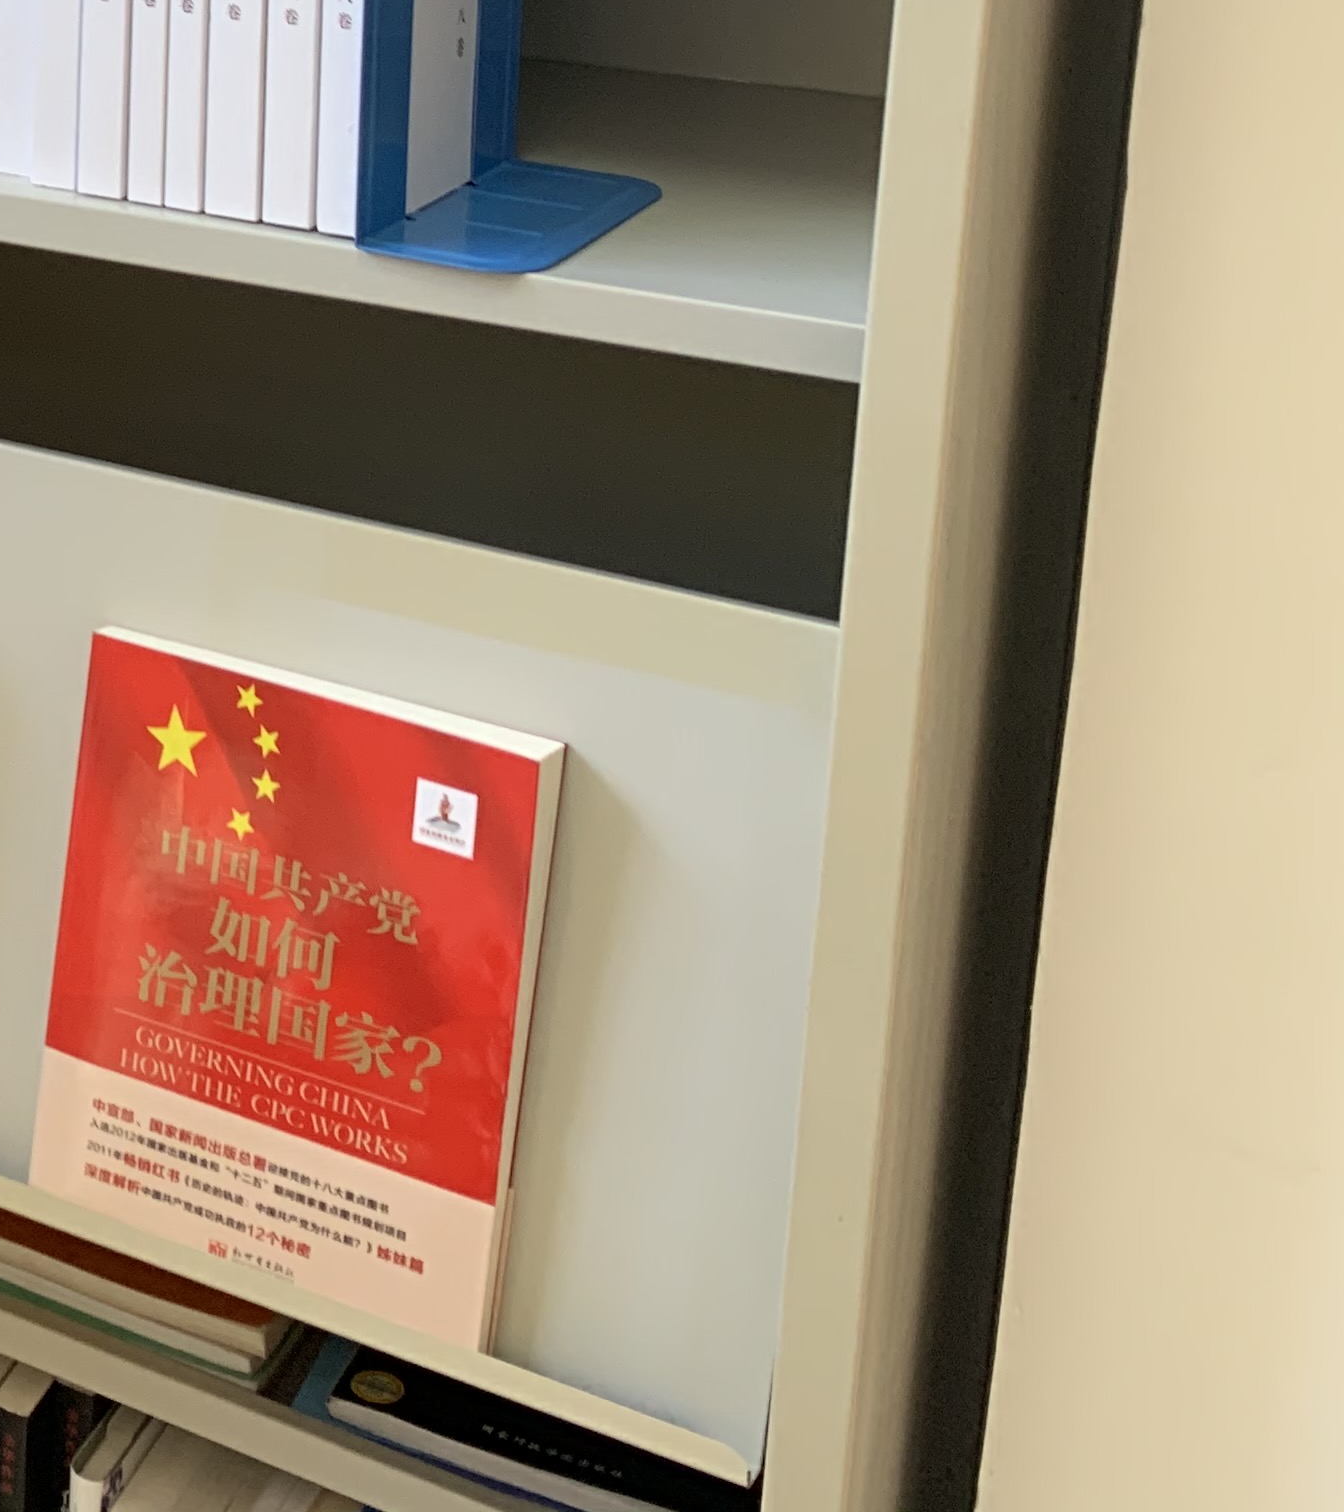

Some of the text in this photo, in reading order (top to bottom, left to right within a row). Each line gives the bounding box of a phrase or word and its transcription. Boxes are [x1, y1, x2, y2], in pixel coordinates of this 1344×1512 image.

[158, 826, 420, 946] 中国共产党
[209, 896, 339, 991] 如何
[135, 1025, 390, 1130] GOVERNING CHINA
[136, 942, 443, 1094] 治理国家？
[118, 1045, 409, 1165] HOW THE CPC WORKS
